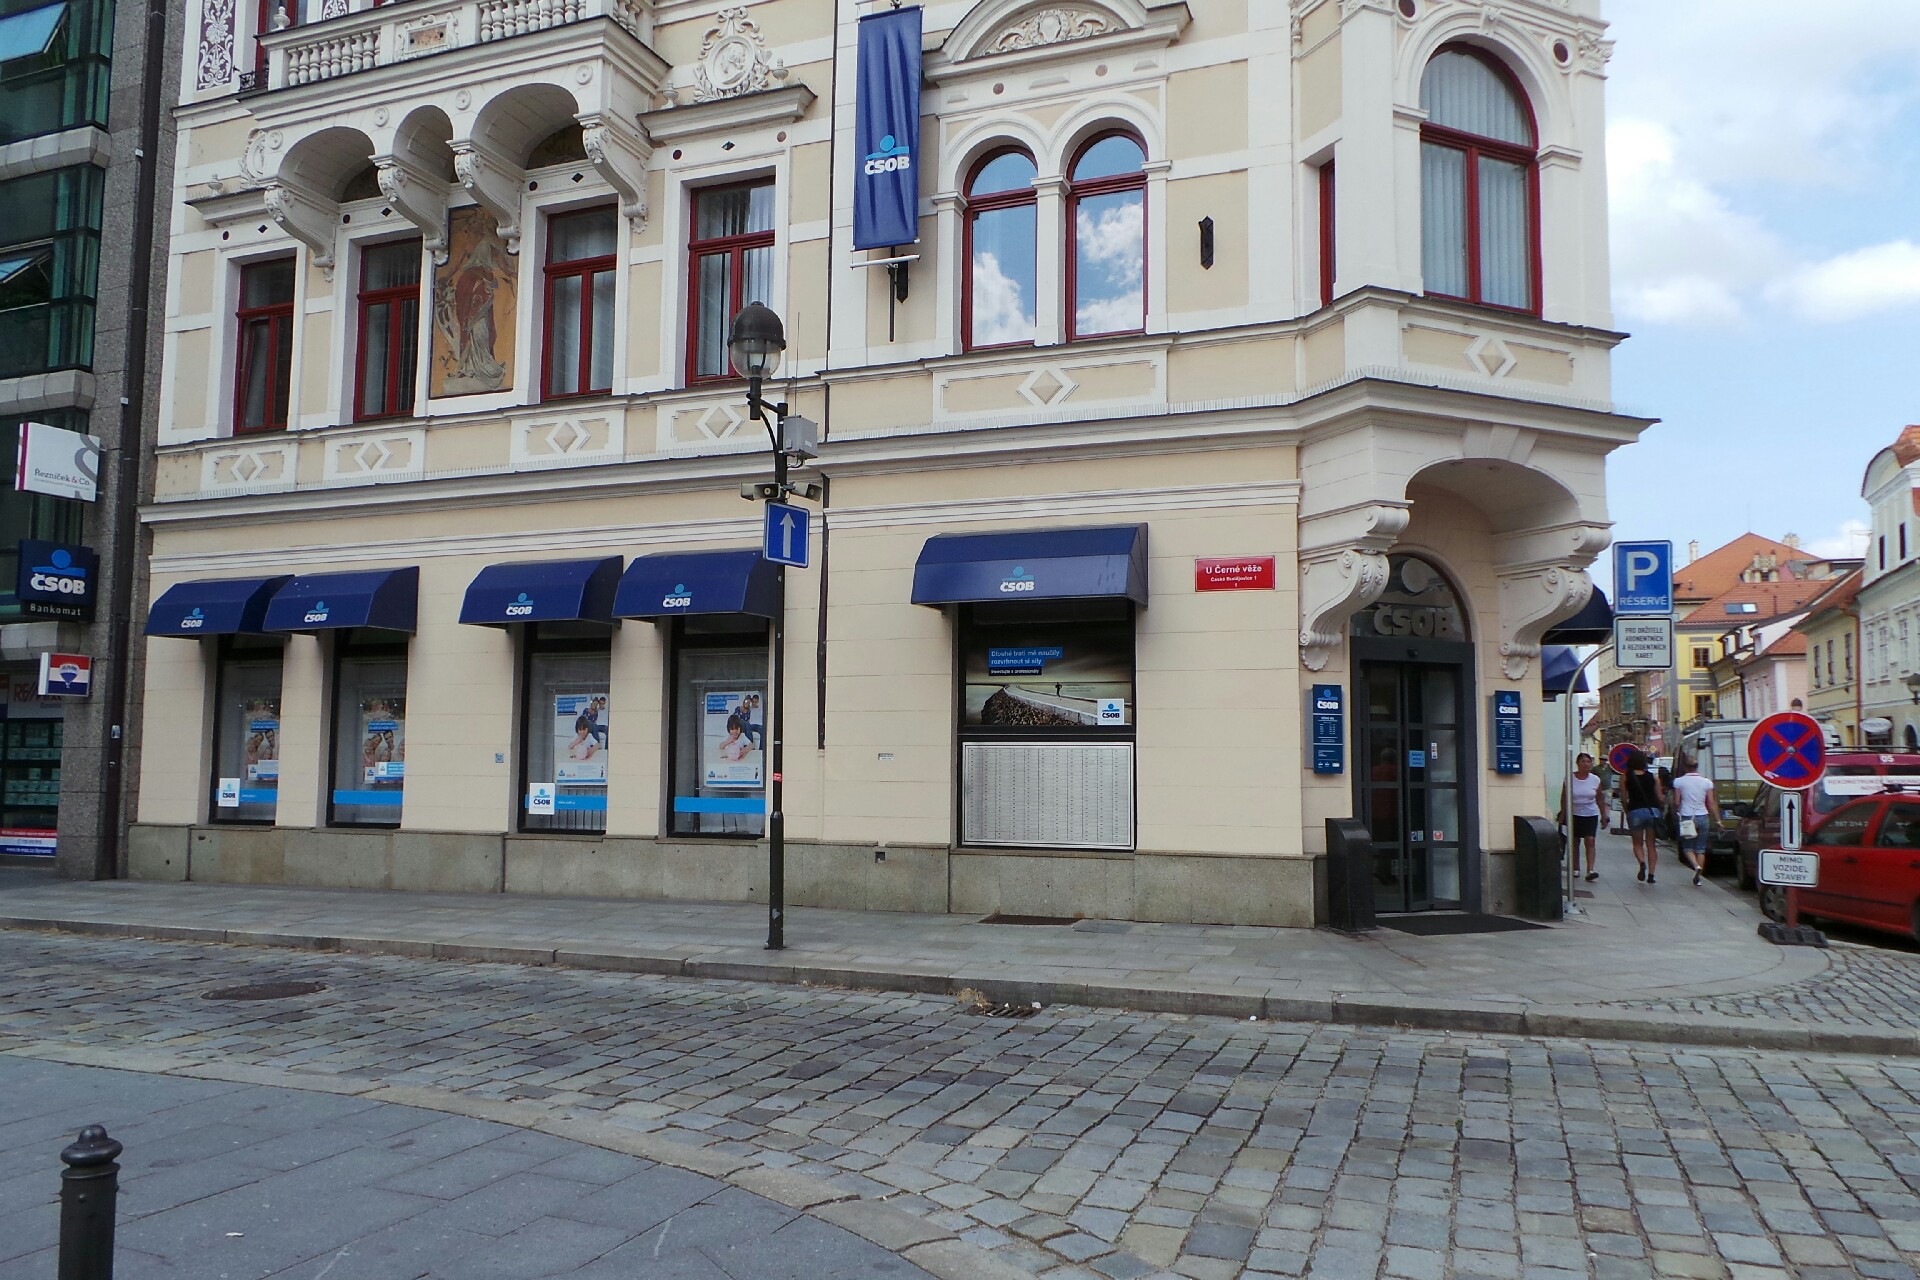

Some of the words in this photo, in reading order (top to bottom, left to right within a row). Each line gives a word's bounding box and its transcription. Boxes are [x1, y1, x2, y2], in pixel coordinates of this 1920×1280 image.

[864, 156, 910, 175] ČSOB
[71, 476, 78, 484] &
[1205, 566, 1212, 574] U
[1214, 564, 1240, 574] Černé
[1242, 564, 1262, 573] věže
[1626, 551, 1659, 591] P
[30, 573, 85, 595] ČSOB
[1000, 581, 1035, 592] ČSOB
[662, 597, 691, 608] ČSOB
[1619, 595, 1668, 606] RÉSERVÉ
[30, 603, 81, 616] Bankomat
[505, 606, 533, 616] ČSOB
[304, 613, 328, 623] ČSOB
[1373, 603, 1454, 637] ČSOB
[181, 619, 203, 628] ČSOB
[991, 649, 1012, 657] Dlouhé
[1317, 701, 1339, 709] ČSOB
[1499, 706, 1518, 714] ČSOB
[1779, 856, 1803, 864] MIMO
[1773, 864, 1809, 873] VOZIDEL
[1775, 872, 1808, 881] STAVBY
